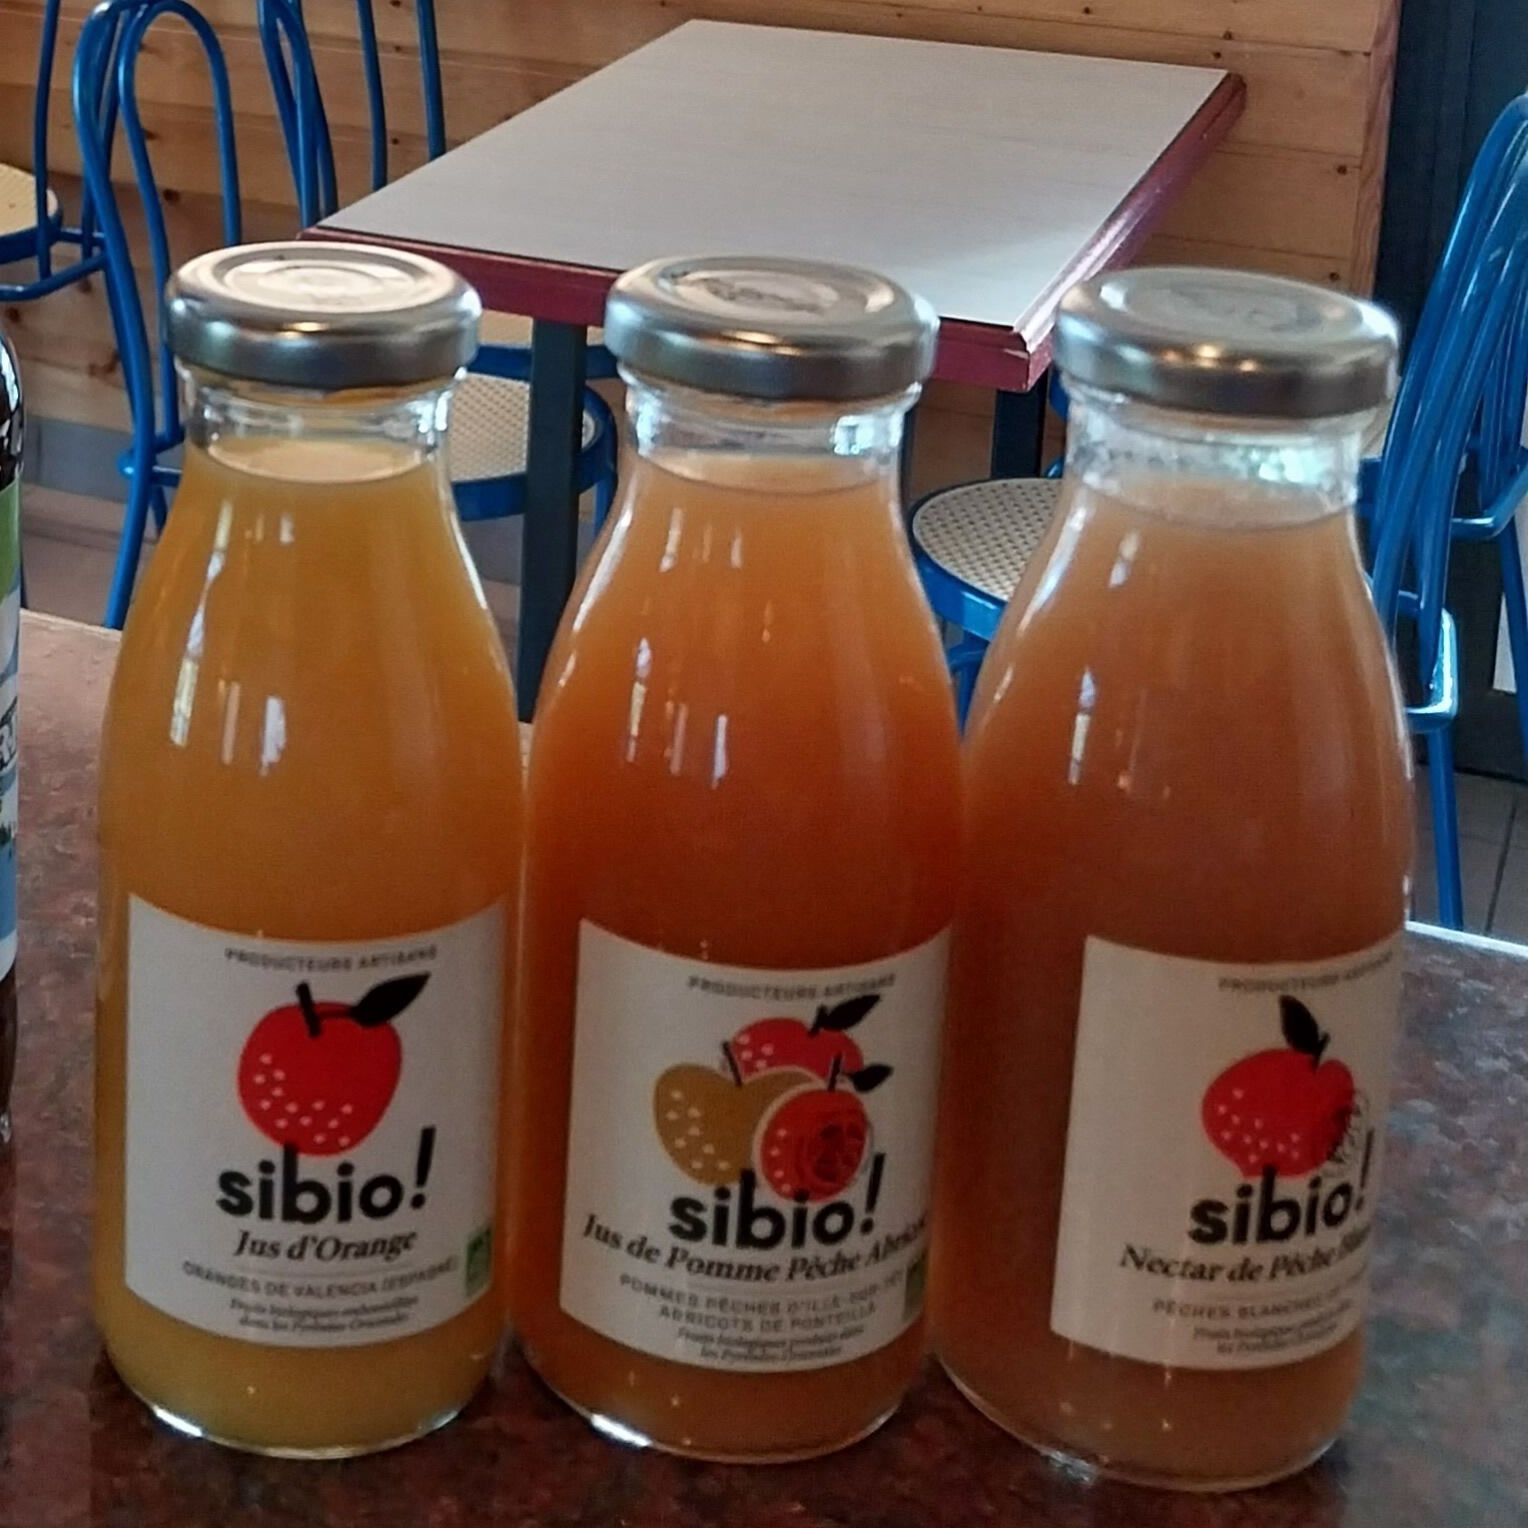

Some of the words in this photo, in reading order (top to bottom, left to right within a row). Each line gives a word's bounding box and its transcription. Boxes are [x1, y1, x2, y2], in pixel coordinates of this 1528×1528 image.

[215, 1124, 437, 1225] sibio!
[1188, 1128, 1375, 1246] sibio!
[668, 1152, 886, 1251] sibio!
[233, 1229, 281, 1258] Jus
[286, 1230, 419, 1263] d'Orange
[582, 1213, 622, 1250] Jus
[626, 1234, 662, 1264] de
[665, 1245, 778, 1283] Pomme
[786, 1249, 861, 1283] Pêche
[1119, 1243, 1225, 1281] Nectar
[1227, 1257, 1265, 1282] de
[264, 1276, 287, 1297] DE
[292, 1279, 378, 1300] VALENCIA
[619, 1274, 698, 1306] POMMES
[658, 1303, 753, 1332] ABRICOTS
[759, 1313, 785, 1332] DE
